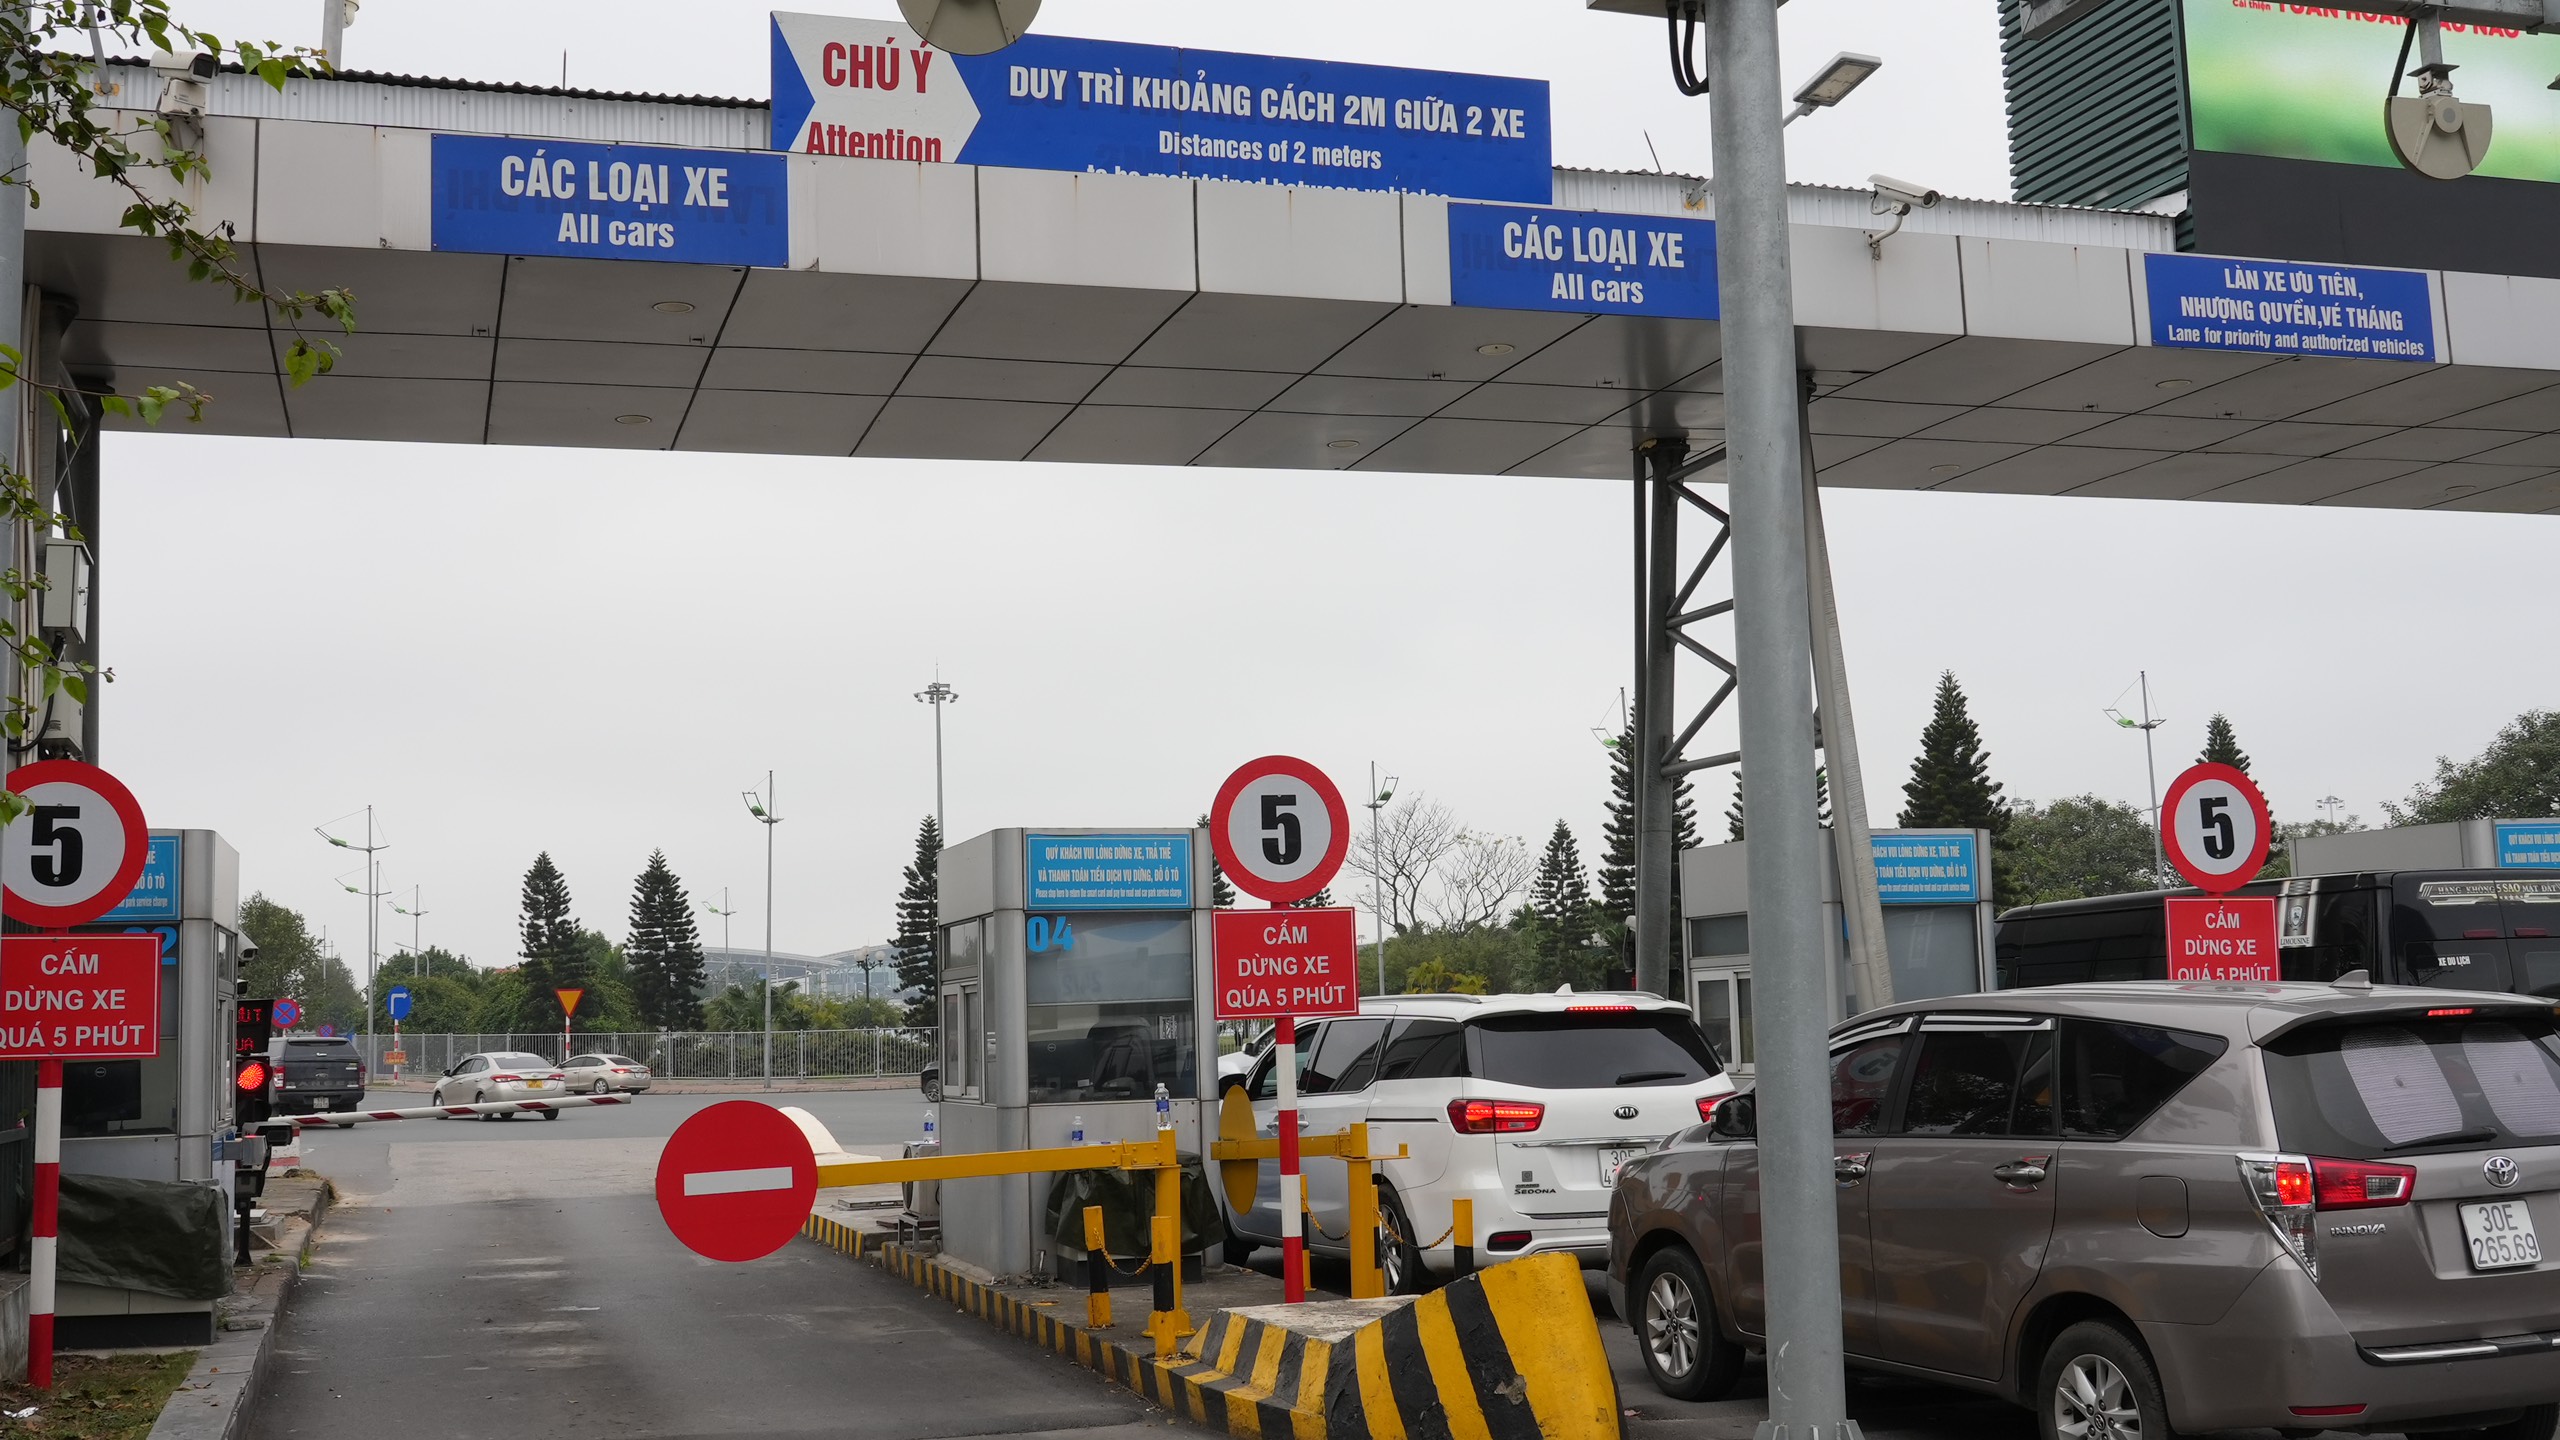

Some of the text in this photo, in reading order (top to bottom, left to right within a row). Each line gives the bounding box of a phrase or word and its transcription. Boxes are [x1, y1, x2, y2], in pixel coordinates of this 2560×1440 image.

[823, 37, 933, 93] CHÚ Ý
[1010, 65, 1525, 138] DUY TRÌ KHOẢNG CÁCH 2M GIỮA 2 XE
[806, 122, 942, 162] Attention
[1158, 130, 1382, 170] Distances of 2 meters
[500, 149, 729, 212] CÁC LOẠI XE
[558, 212, 674, 248] All cars
[1503, 215, 1684, 272] CÁC LOẠI XE
[1551, 272, 1644, 304] All cars
[2224, 264, 2364, 300] LÀN XE ƯU TIÊN,
[2180, 296, 2255, 324] NHƯỢNG
[2345, 304, 2404, 332] THÁNG
[2168, 324, 2425, 356] Lane for priority and authorized vehicles
[1260, 794, 1302, 866] 5
[2199, 796, 2235, 860] 5
[30, 806, 83, 887] 5
[1046, 844, 1058, 861] QUÝ
[1060, 844, 1082, 860] KHÁCH
[1083, 846, 1094, 860] VUI
[1096, 844, 1113, 860] LÒNG
[1114, 844, 1132, 860] DỪNG
[1145, 842, 1158, 860] TRẢ
[1158, 842, 1172, 860] THẺ
[154, 872, 165, 889] TÔ
[1038, 866, 1048, 882] VÀ
[1048, 869, 1070, 882] THANH
[1071, 866, 1089, 882] TOÁN
[1106, 869, 1122, 884] DỊCH
[1122, 869, 1132, 884] VỤ
[1164, 866, 1170, 882] Ô
[1170, 866, 1179, 882] TÔ
[2496, 884, 2501, 892] 5
[2502, 882, 2520, 892] SAO
[1263, 918, 1308, 945] CẤM
[2205, 906, 2240, 929] CẤM
[1026, 916, 1074, 952] 04
[2185, 934, 2257, 956] DỪNG XE
[2280, 936, 2310, 946] LIMOUSINE
[40, 946, 98, 976] CẤM
[1238, 953, 1330, 977] DỪNG XE
[2178, 962, 2270, 980] QUÁ 5 PHÚT
[5, 984, 126, 1012] DỪNG XE
[1276, 988, 1287, 1006] 5
[1293, 982, 1346, 1006] PHÚT
[54, 1026, 67, 1048] 5
[75, 1020, 146, 1047] PHÚT
[1618, 1108, 1637, 1117] KIA
[2330, 1224, 2386, 1236] INNOVA
[2478, 1204, 2518, 1233] 30E
[2472, 1233, 2539, 1265] 265.69
